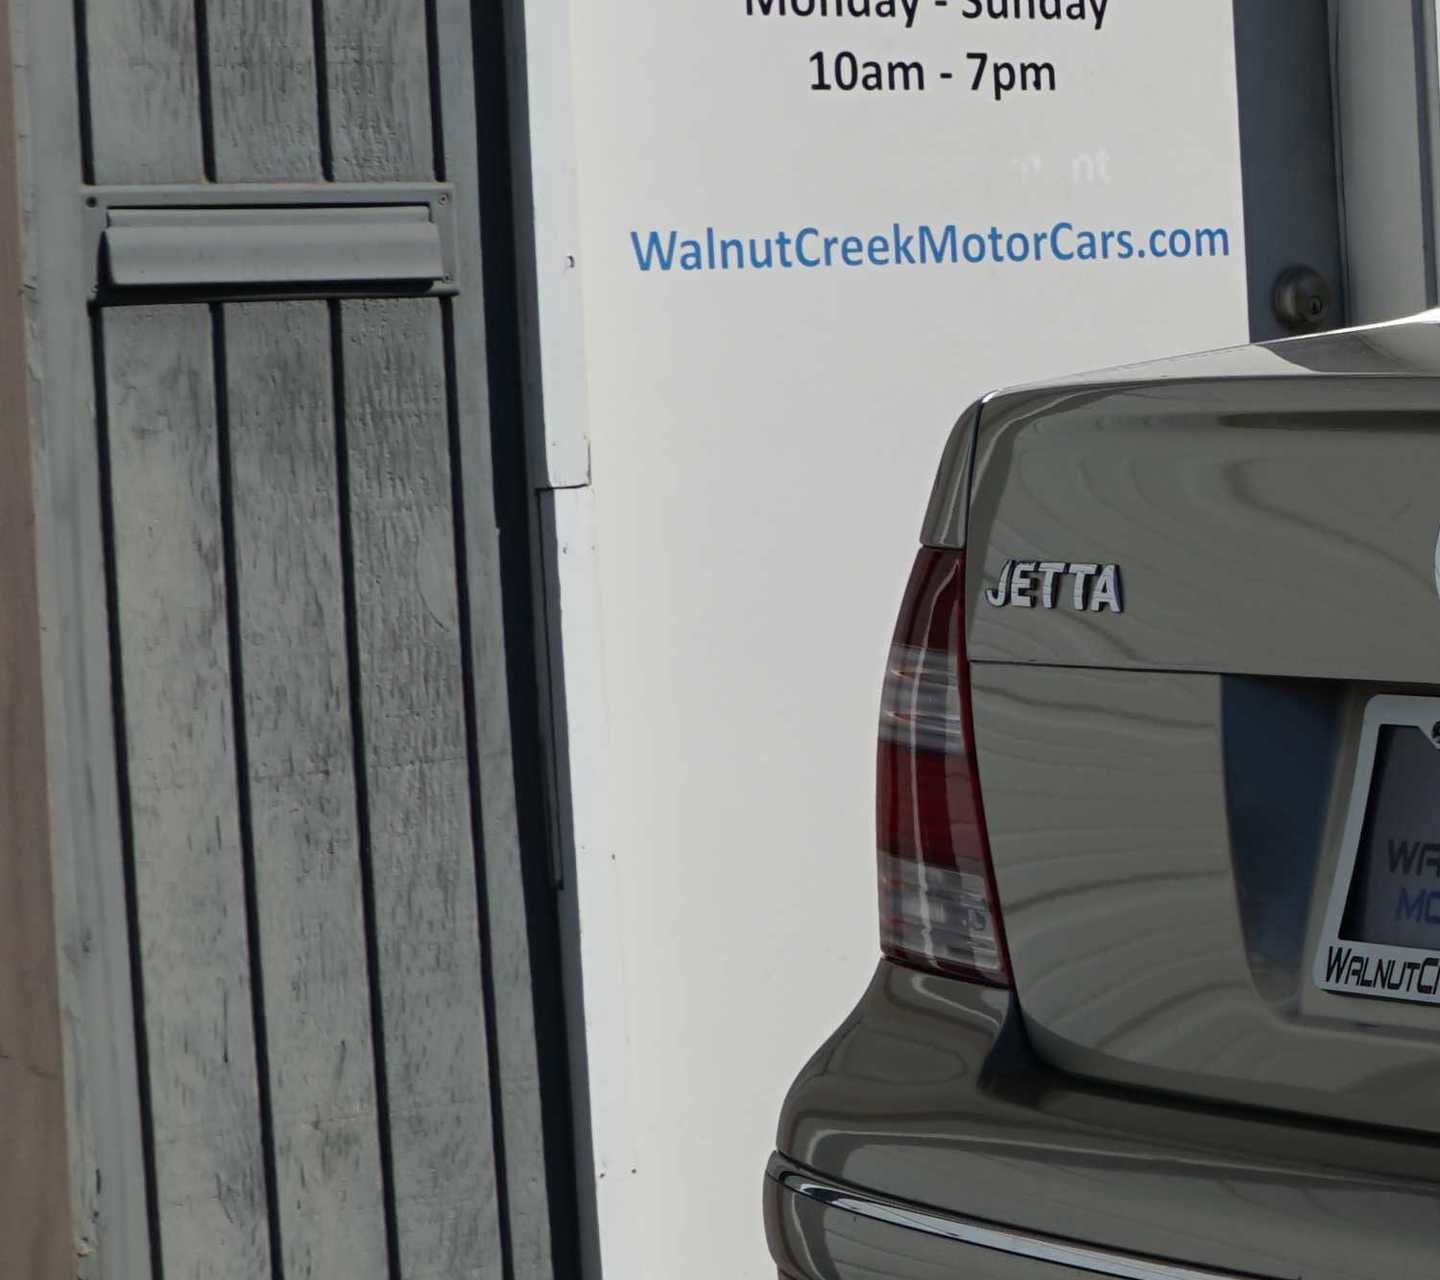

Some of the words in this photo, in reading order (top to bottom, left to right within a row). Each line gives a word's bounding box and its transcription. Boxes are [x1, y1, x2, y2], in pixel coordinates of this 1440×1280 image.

[808, 51, 926, 93] 10am
[966, 51, 1057, 101] 7pm
[631, 221, 1231, 273] WalnutCreekMotorCars.com
[984, 559, 1124, 614] JETTA
